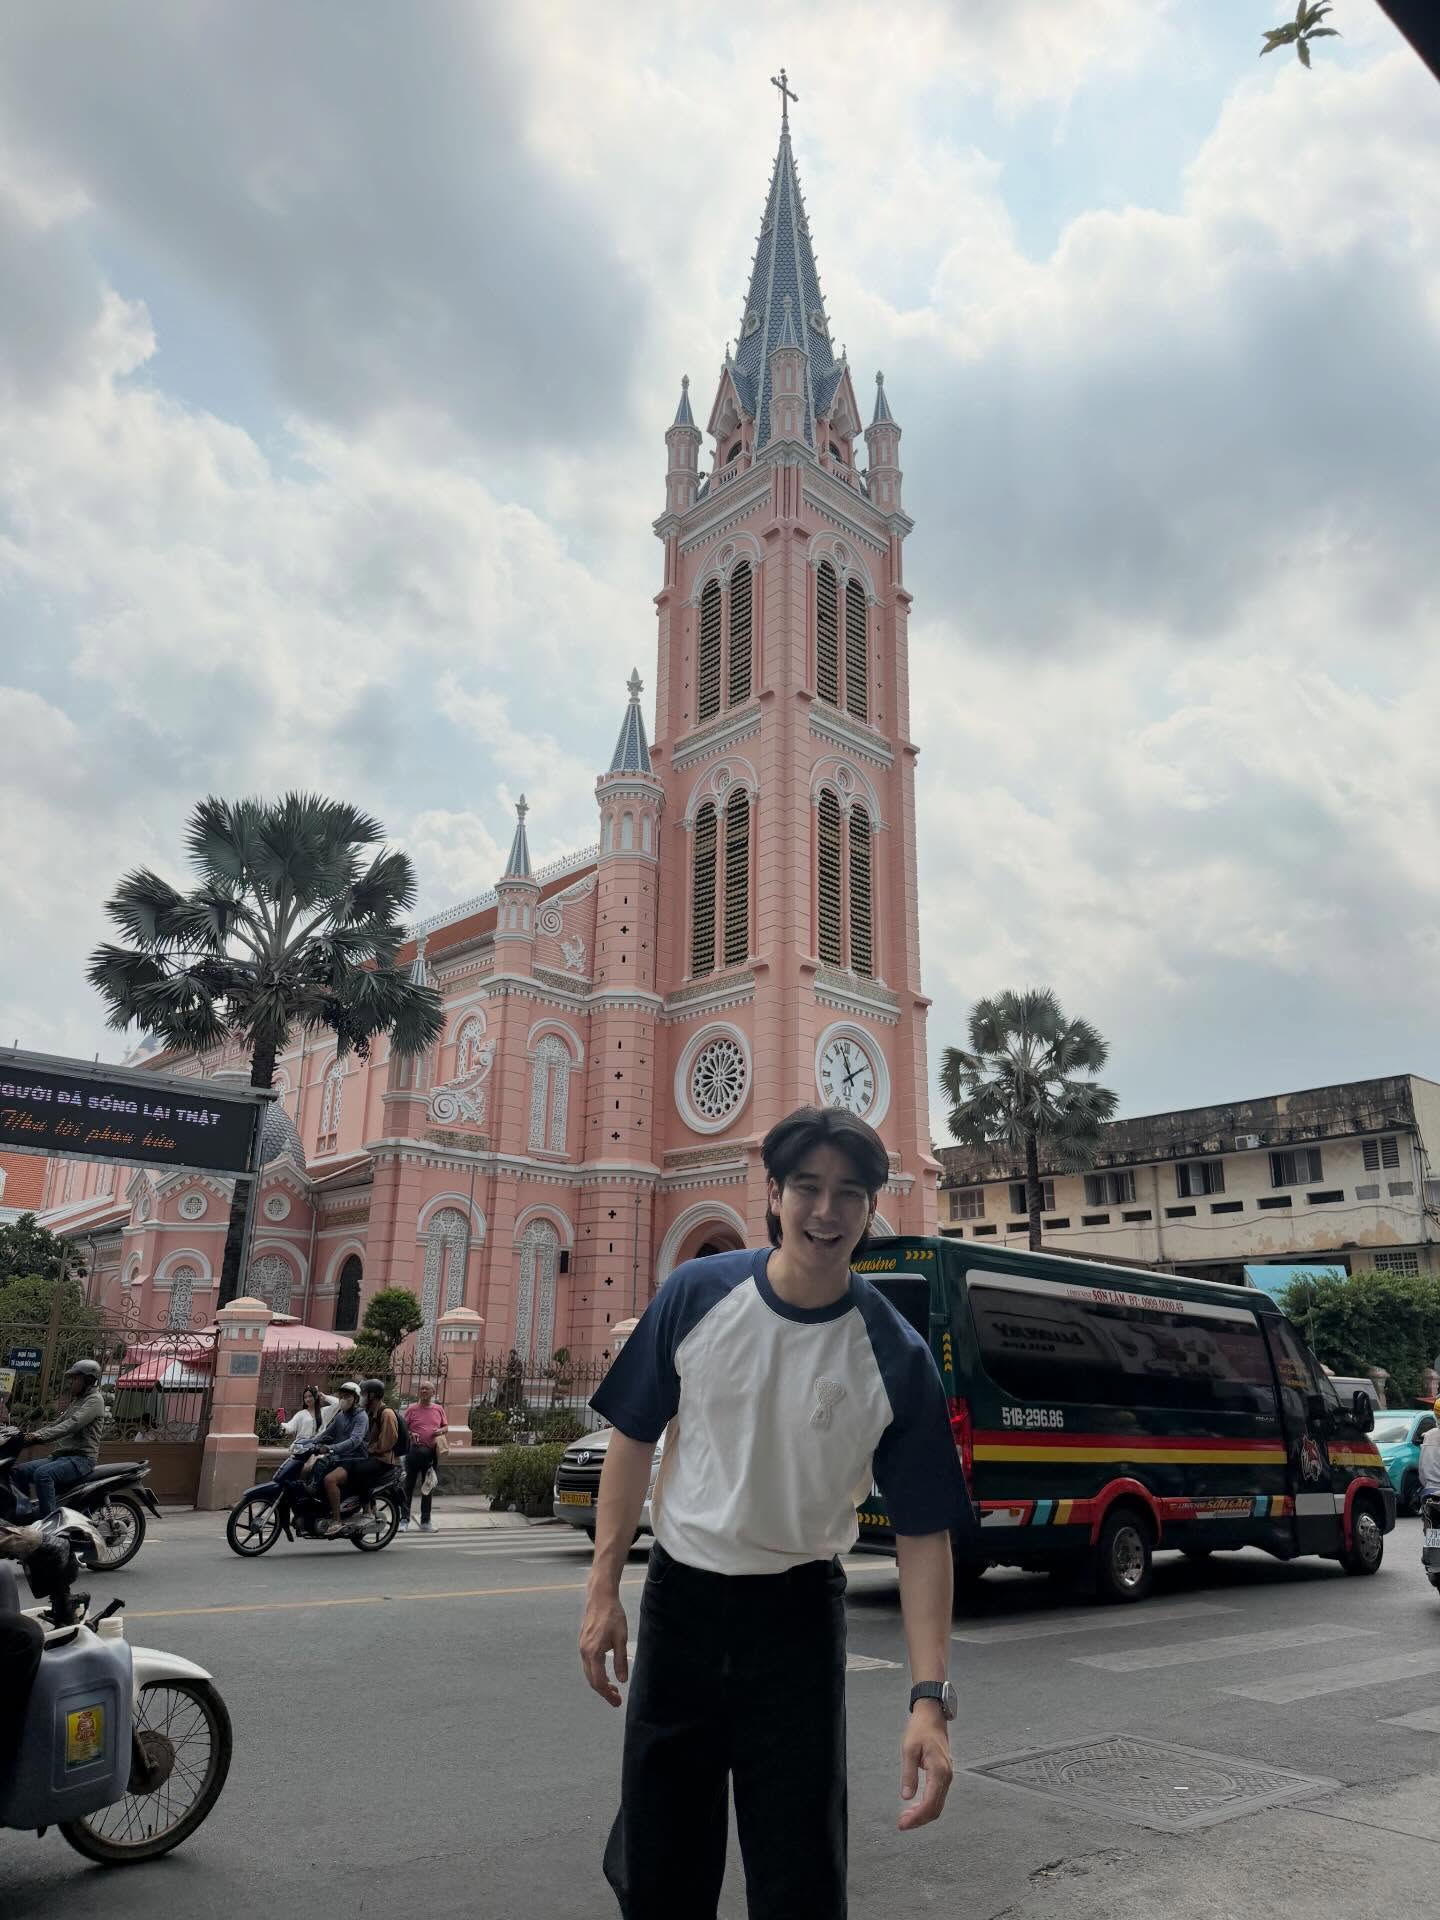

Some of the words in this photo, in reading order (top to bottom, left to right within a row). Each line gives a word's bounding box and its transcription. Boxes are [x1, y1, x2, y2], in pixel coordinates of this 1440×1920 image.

[0, 1082, 52, 1102] GƯỜI
[88, 1094, 137, 1113] SỐNG
[143, 1104, 170, 1121] LẠI
[176, 1109, 221, 1126] THẬT
[1001, 1407, 1064, 1428] 51B-296.86
